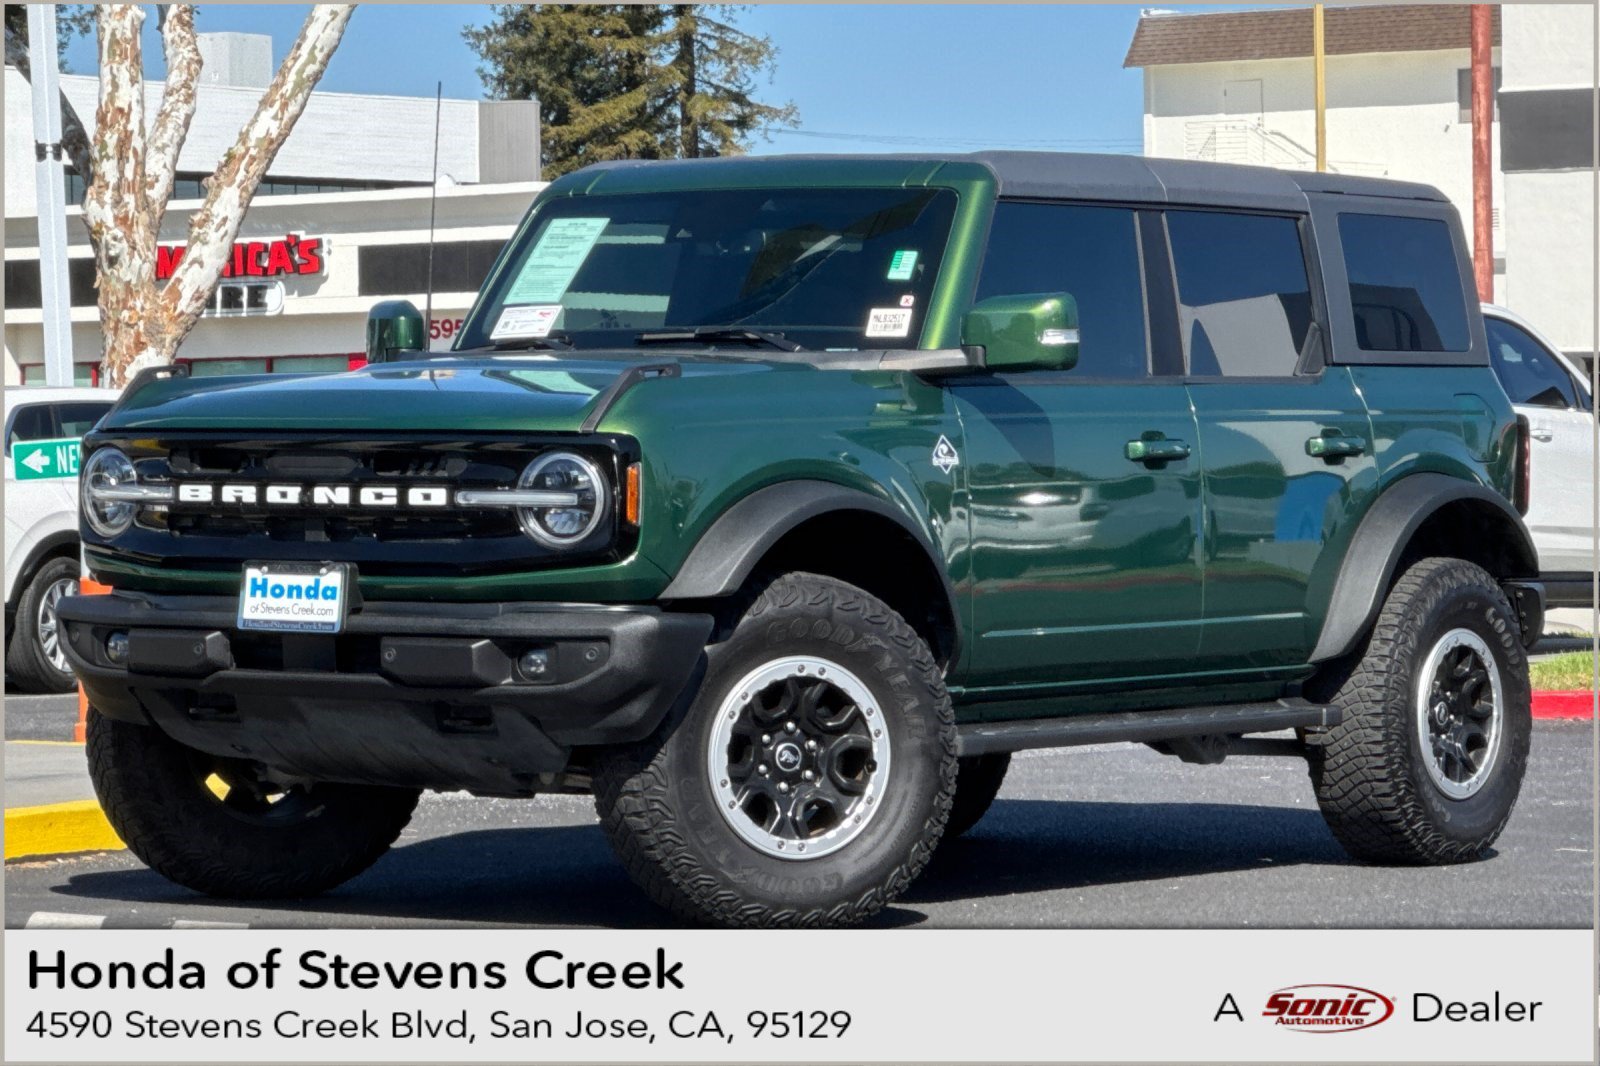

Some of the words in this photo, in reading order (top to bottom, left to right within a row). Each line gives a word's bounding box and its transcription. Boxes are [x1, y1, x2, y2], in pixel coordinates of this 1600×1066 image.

[56, 444, 82, 473] NE
[179, 484, 447, 506] BRONCO
[249, 577, 338, 600] Honda
[250, 603, 260, 613] of
[260, 602, 290, 615] Stevens
[291, 602, 334, 616] Creek.com
